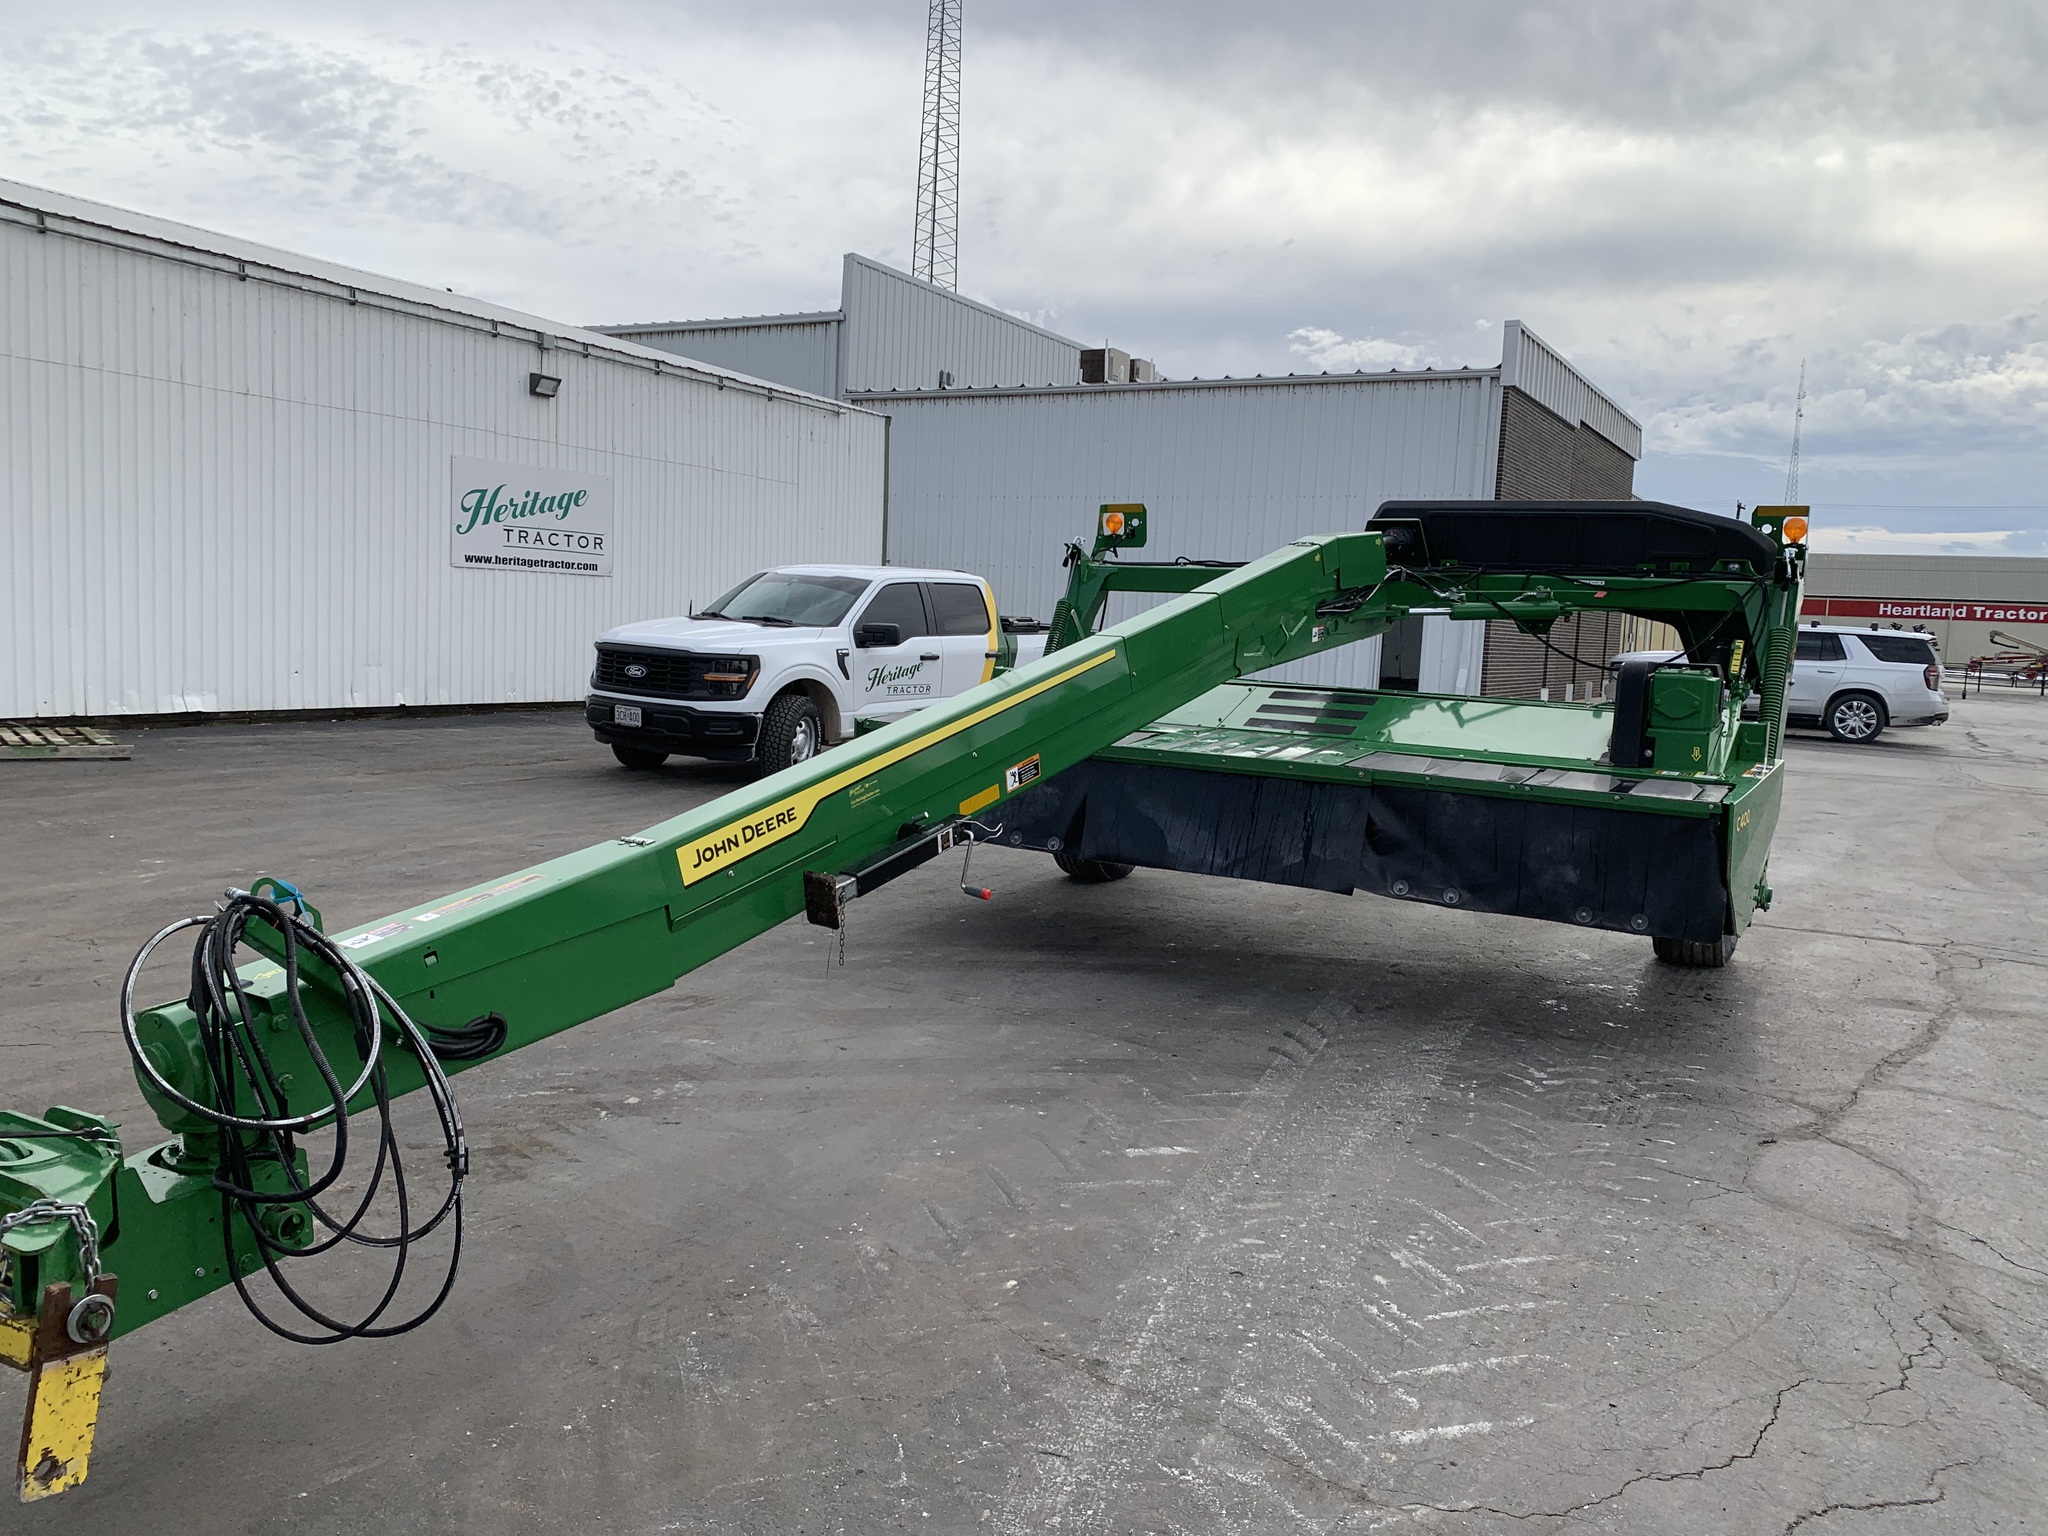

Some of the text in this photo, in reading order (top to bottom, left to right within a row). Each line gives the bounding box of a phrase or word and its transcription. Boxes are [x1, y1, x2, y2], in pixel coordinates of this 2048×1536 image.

[456, 484, 589, 535] Heritage
[503, 528, 604, 550] TRACTOR
[464, 554, 598, 571] www.heritagetractor.com
[1879, 603, 2048, 621] Heartland Tractor
[865, 662, 923, 692] Heritage
[887, 685, 931, 695] TRACTOR
[693, 806, 797, 868] JOHN DEERE
